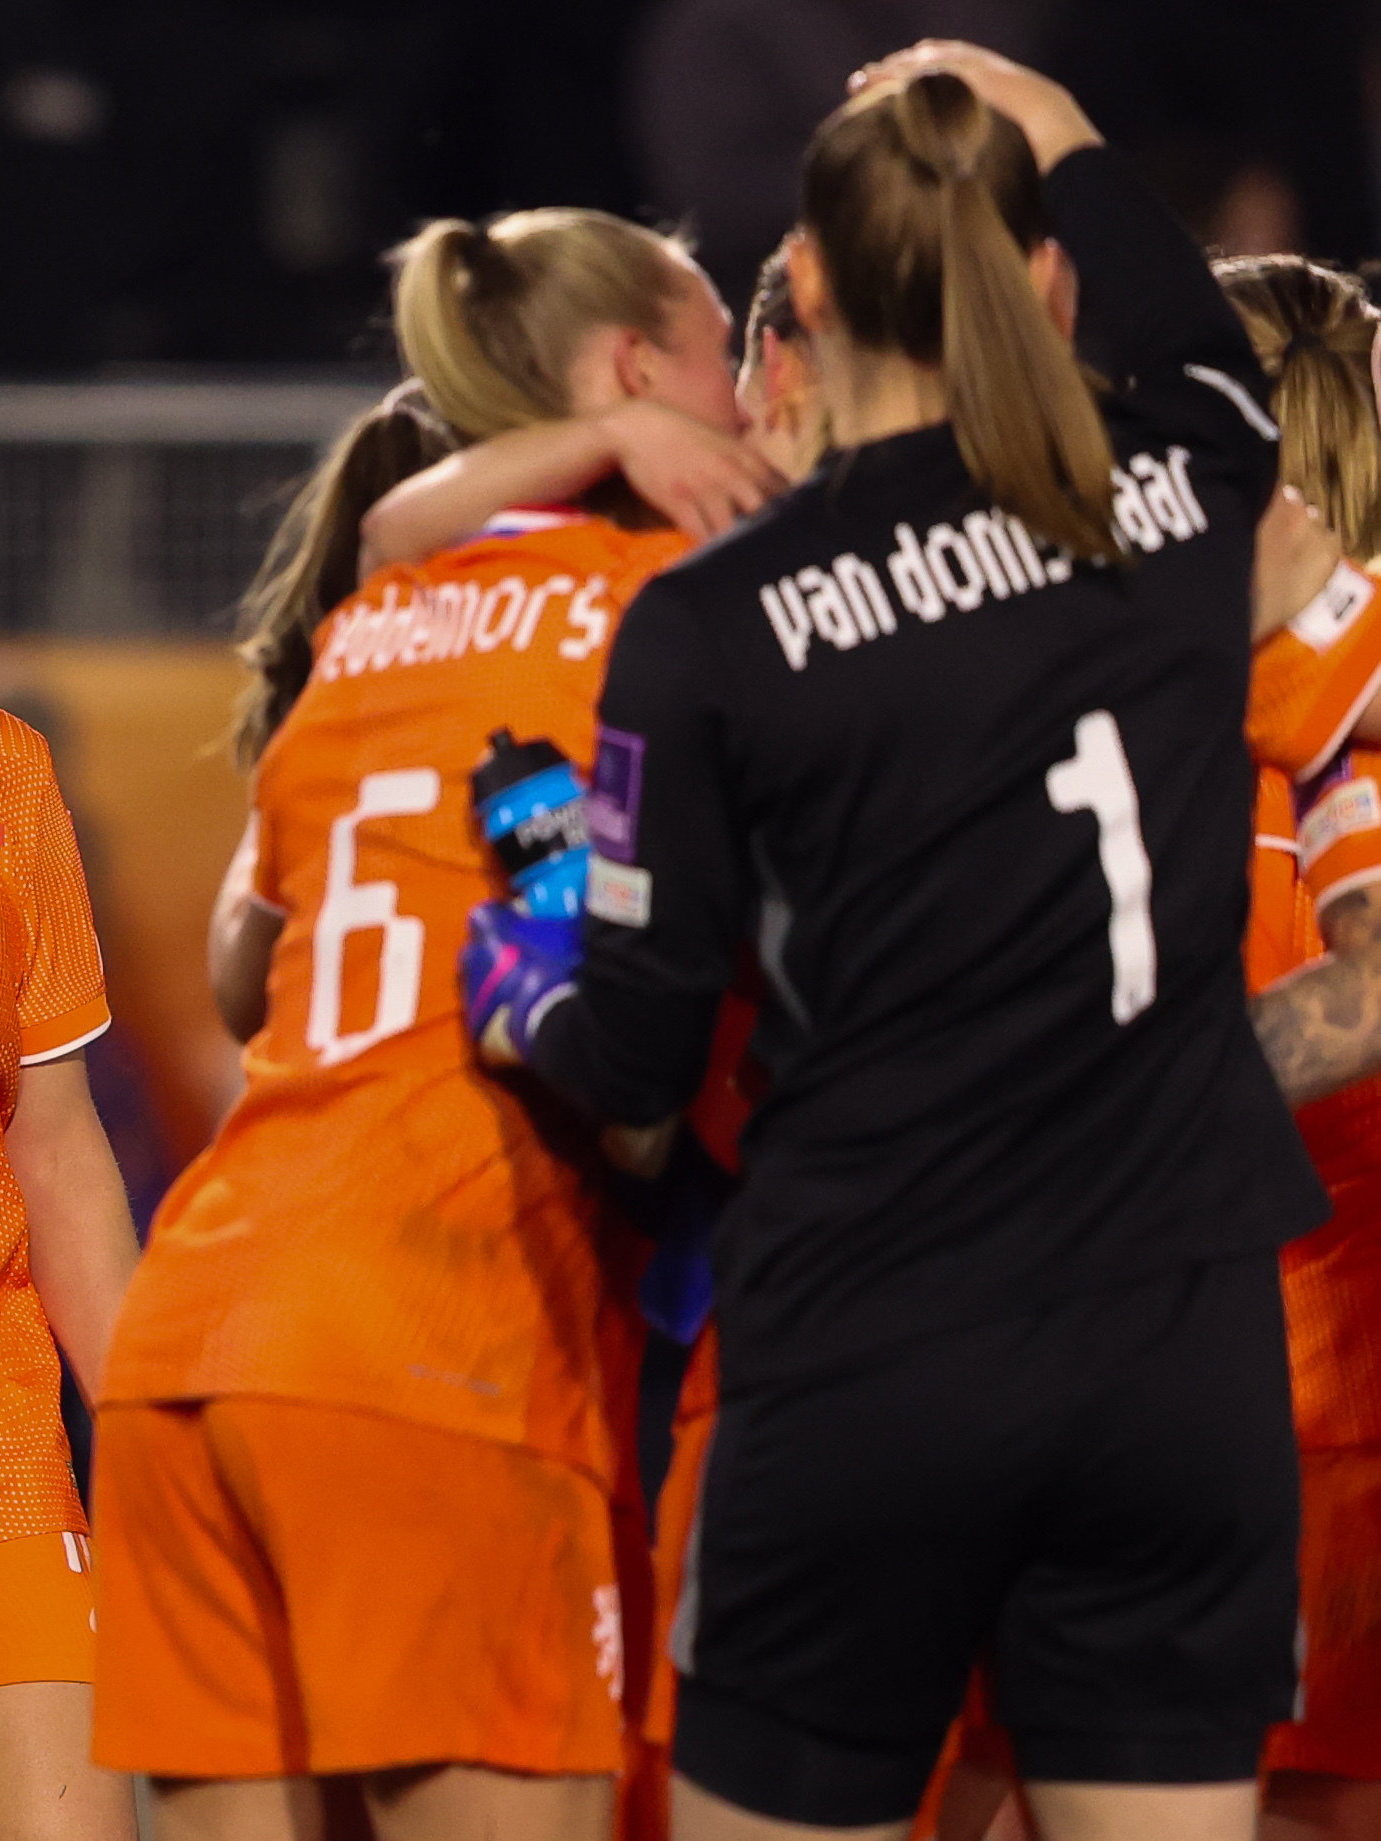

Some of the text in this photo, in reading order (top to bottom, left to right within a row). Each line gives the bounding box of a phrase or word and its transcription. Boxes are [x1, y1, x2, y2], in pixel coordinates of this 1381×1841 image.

[759, 445, 1209, 671] van domaar
[306, 767, 441, 1067] 6
[1044, 709, 1157, 1025] 1
